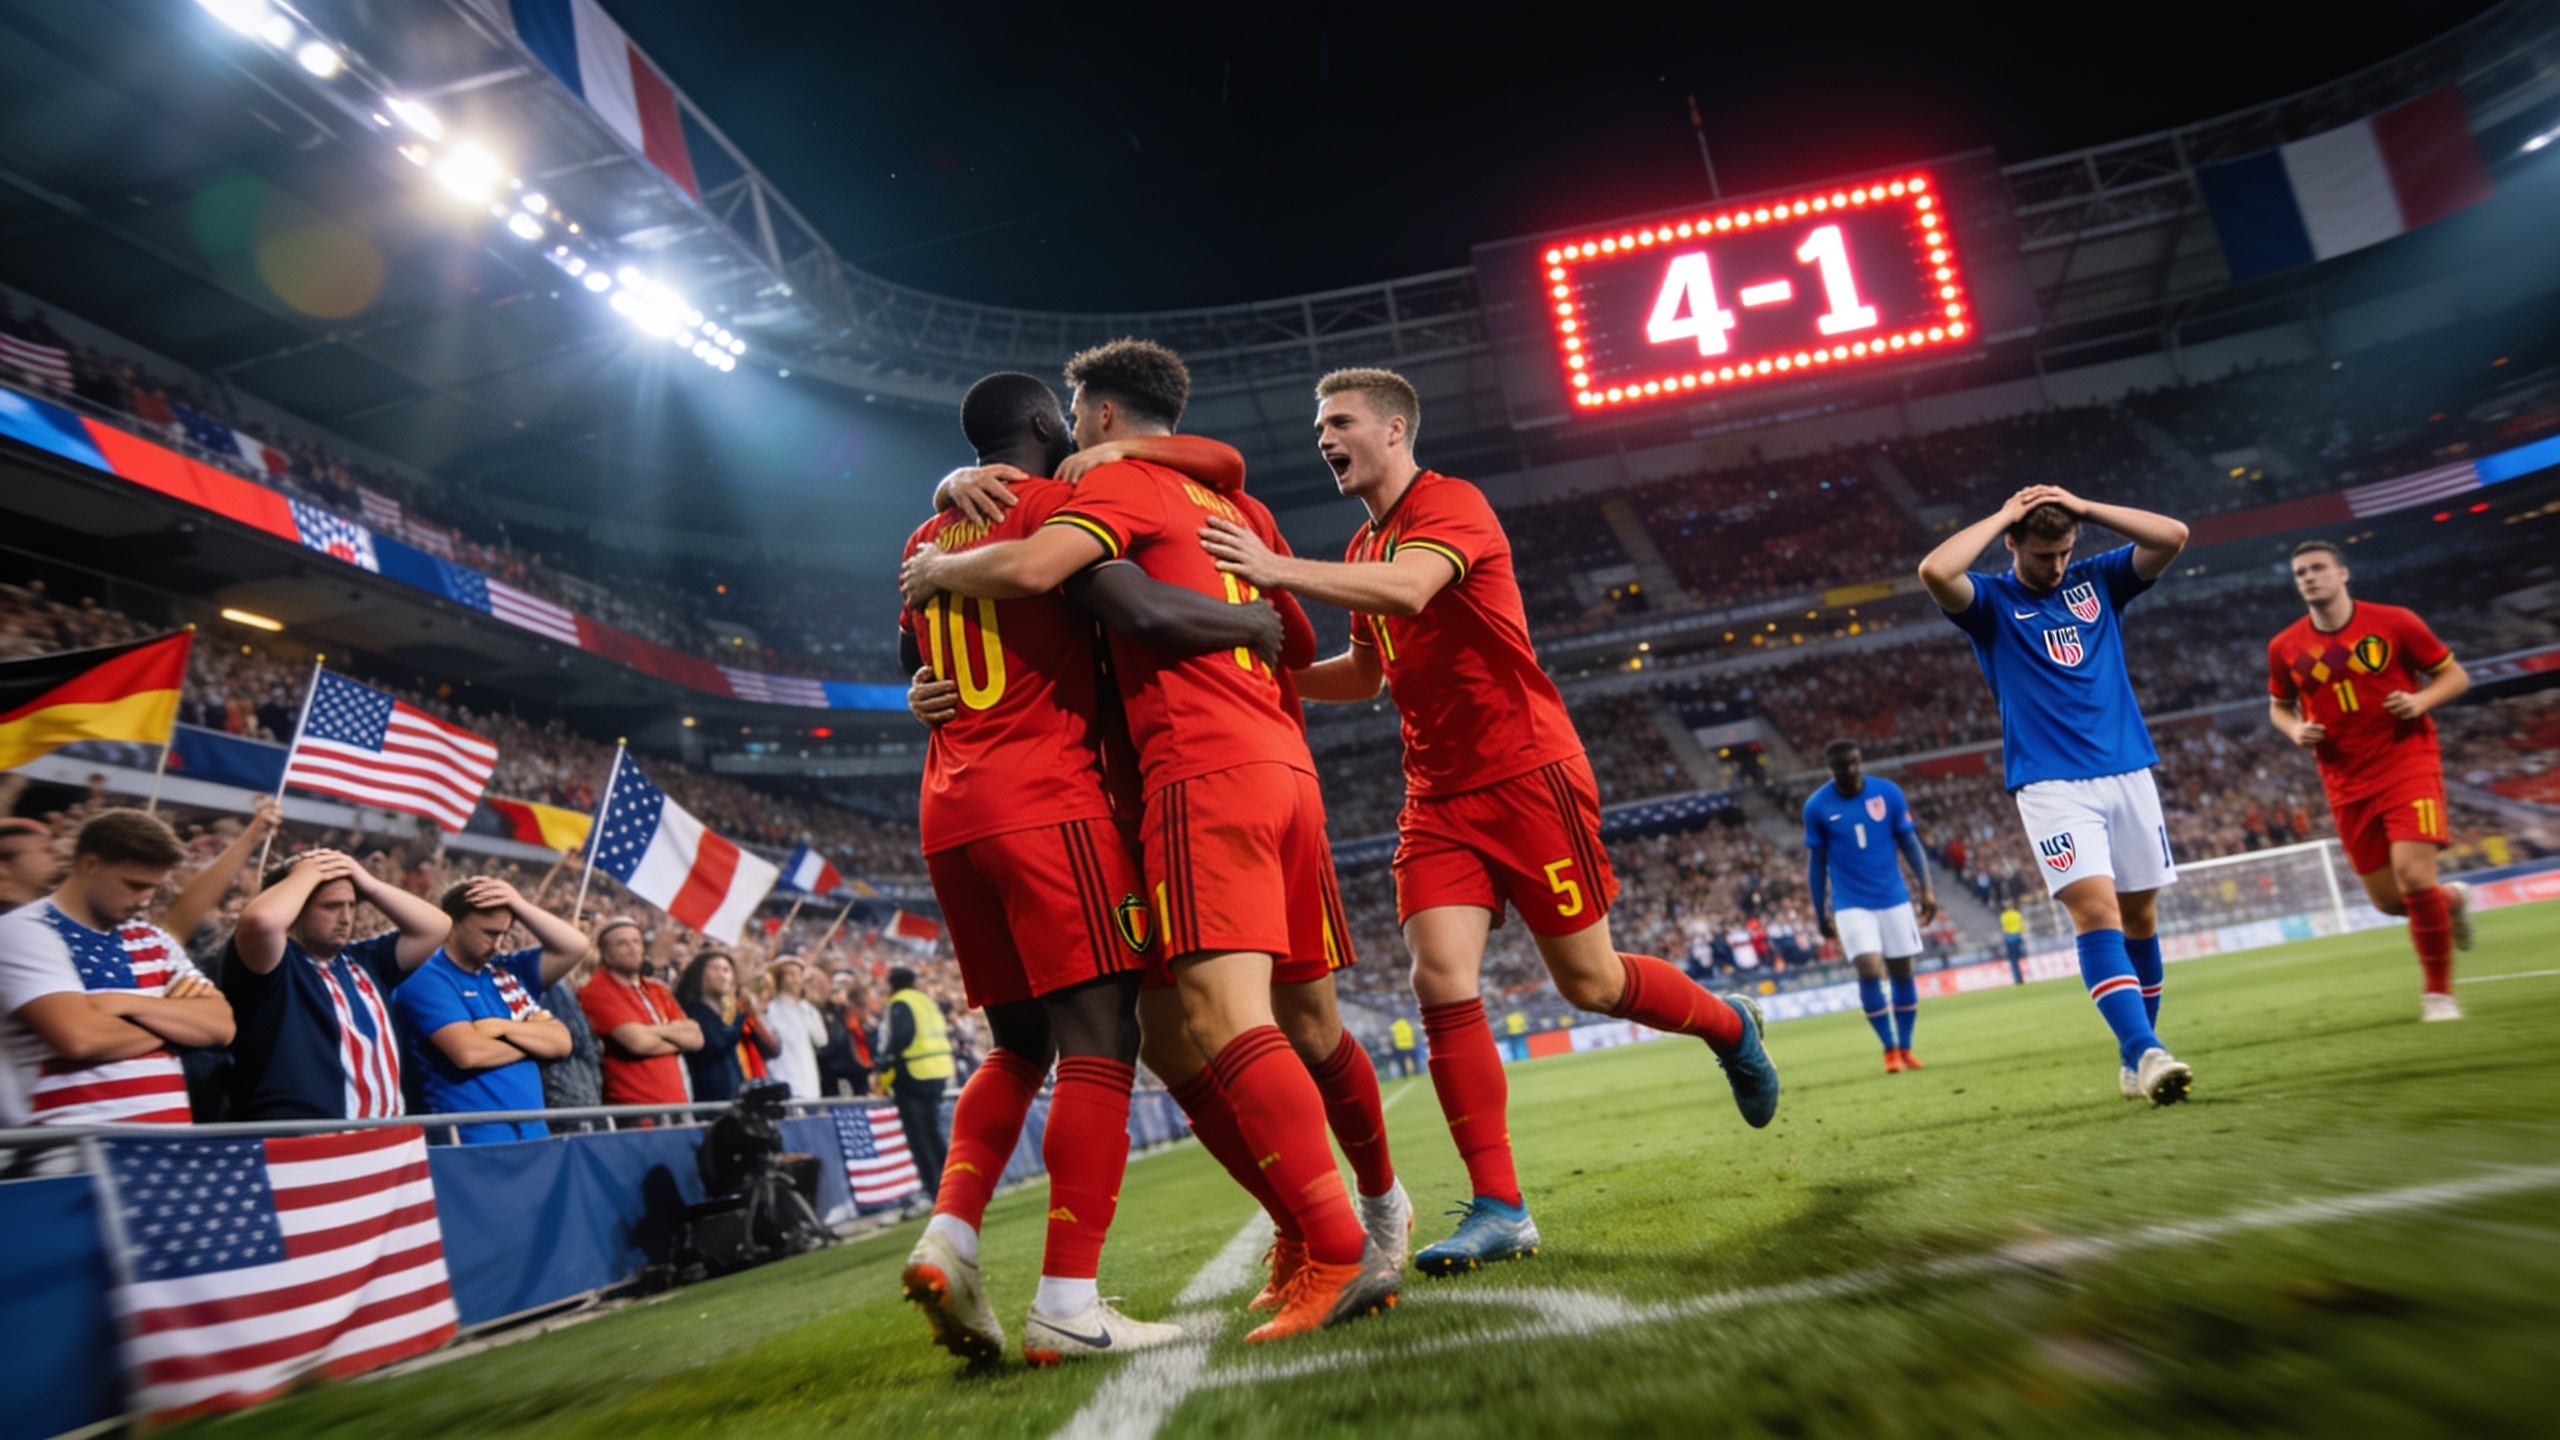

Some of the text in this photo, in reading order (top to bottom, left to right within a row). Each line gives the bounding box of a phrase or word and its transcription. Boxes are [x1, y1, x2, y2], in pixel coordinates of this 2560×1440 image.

[1645, 224, 1878, 357] 4-1
[925, 592, 1006, 710] 10
[2333, 679, 2360, 713] 11
[2412, 798, 2438, 836] 11
[1543, 857, 1583, 917] 5
